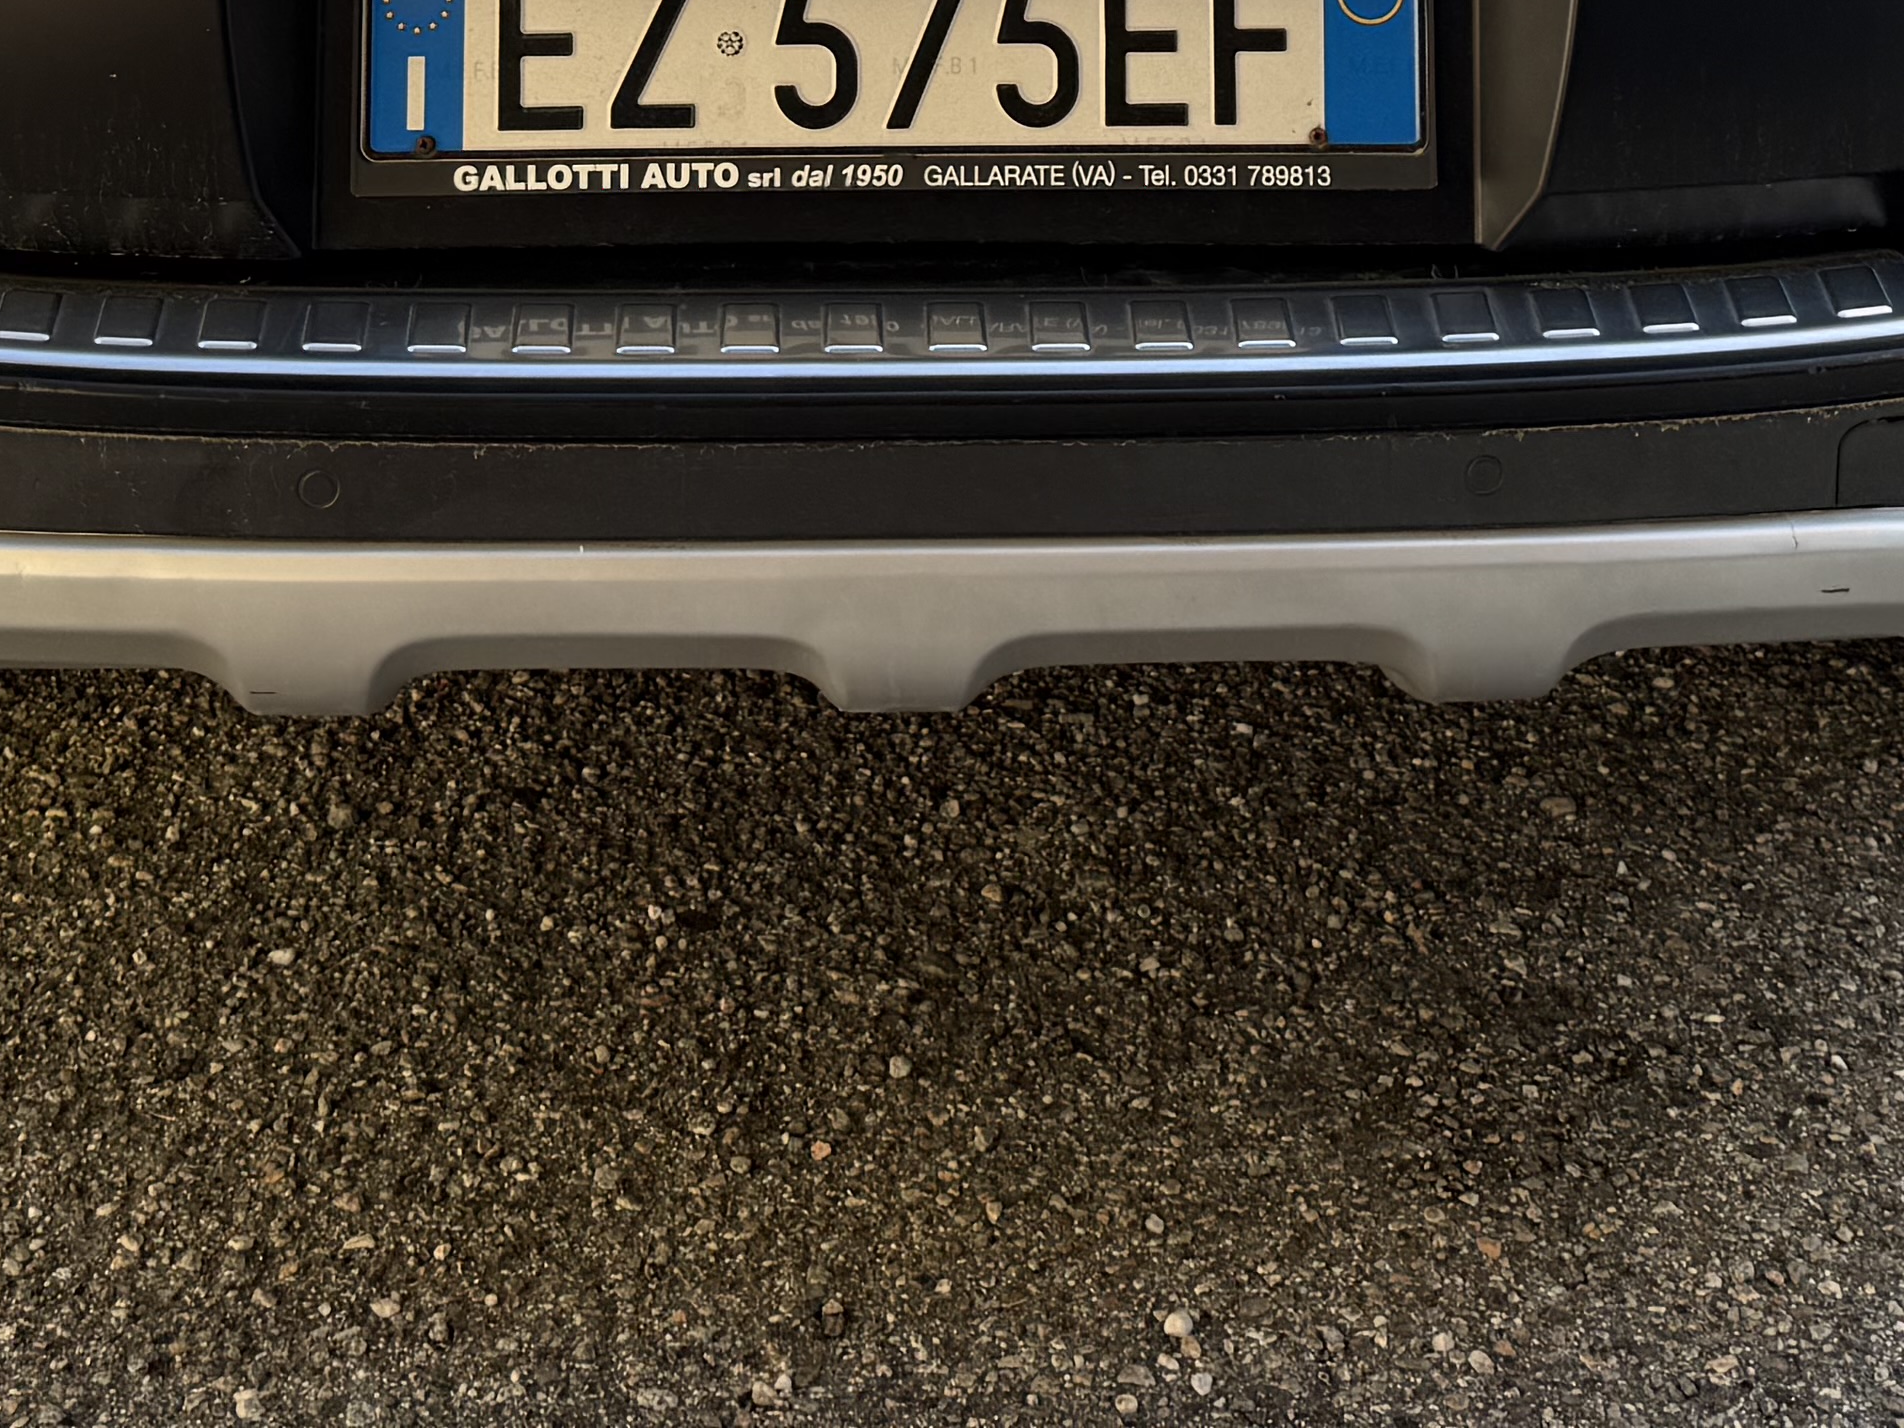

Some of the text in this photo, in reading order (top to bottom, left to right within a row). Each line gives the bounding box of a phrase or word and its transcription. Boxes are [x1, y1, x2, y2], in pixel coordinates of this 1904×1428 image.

[453, 163, 630, 192] GALLOTTI
[641, 162, 739, 189] AUTO
[747, 170, 781, 188] srl
[791, 164, 832, 187] dal
[841, 163, 904, 187] 1950
[923, 164, 1066, 187] GALLARATE
[1072, 160, 1116, 188] (VA)
[1138, 164, 1177, 186] Tel.
[1184, 165, 1238, 186] 0331
[1248, 165, 1332, 187] 789813
